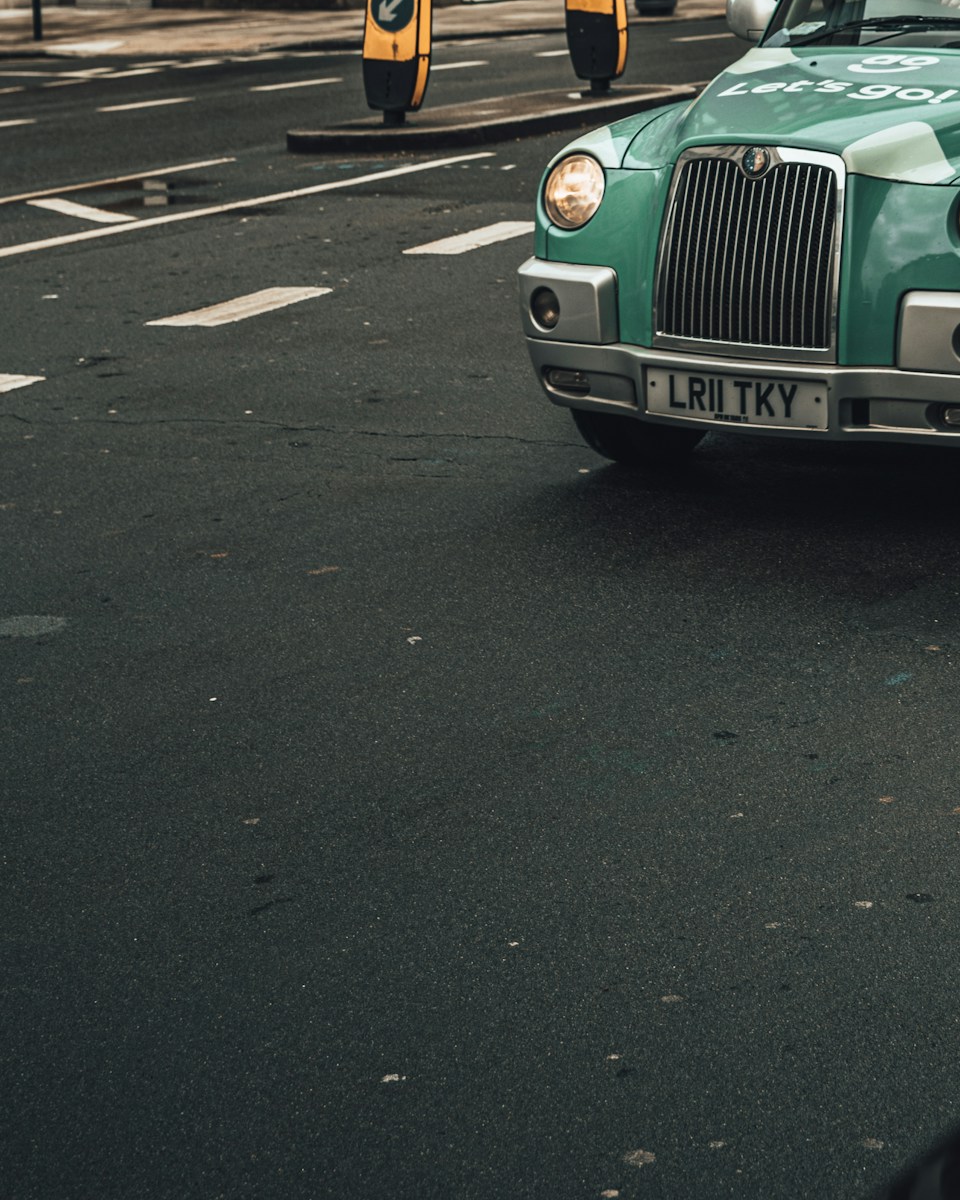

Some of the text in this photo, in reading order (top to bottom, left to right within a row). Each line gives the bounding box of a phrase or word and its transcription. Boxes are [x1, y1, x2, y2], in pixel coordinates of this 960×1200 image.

[861, 54, 940, 66] ao
[717, 79, 959, 104] Let's go!
[733, 380, 798, 418] TKY
